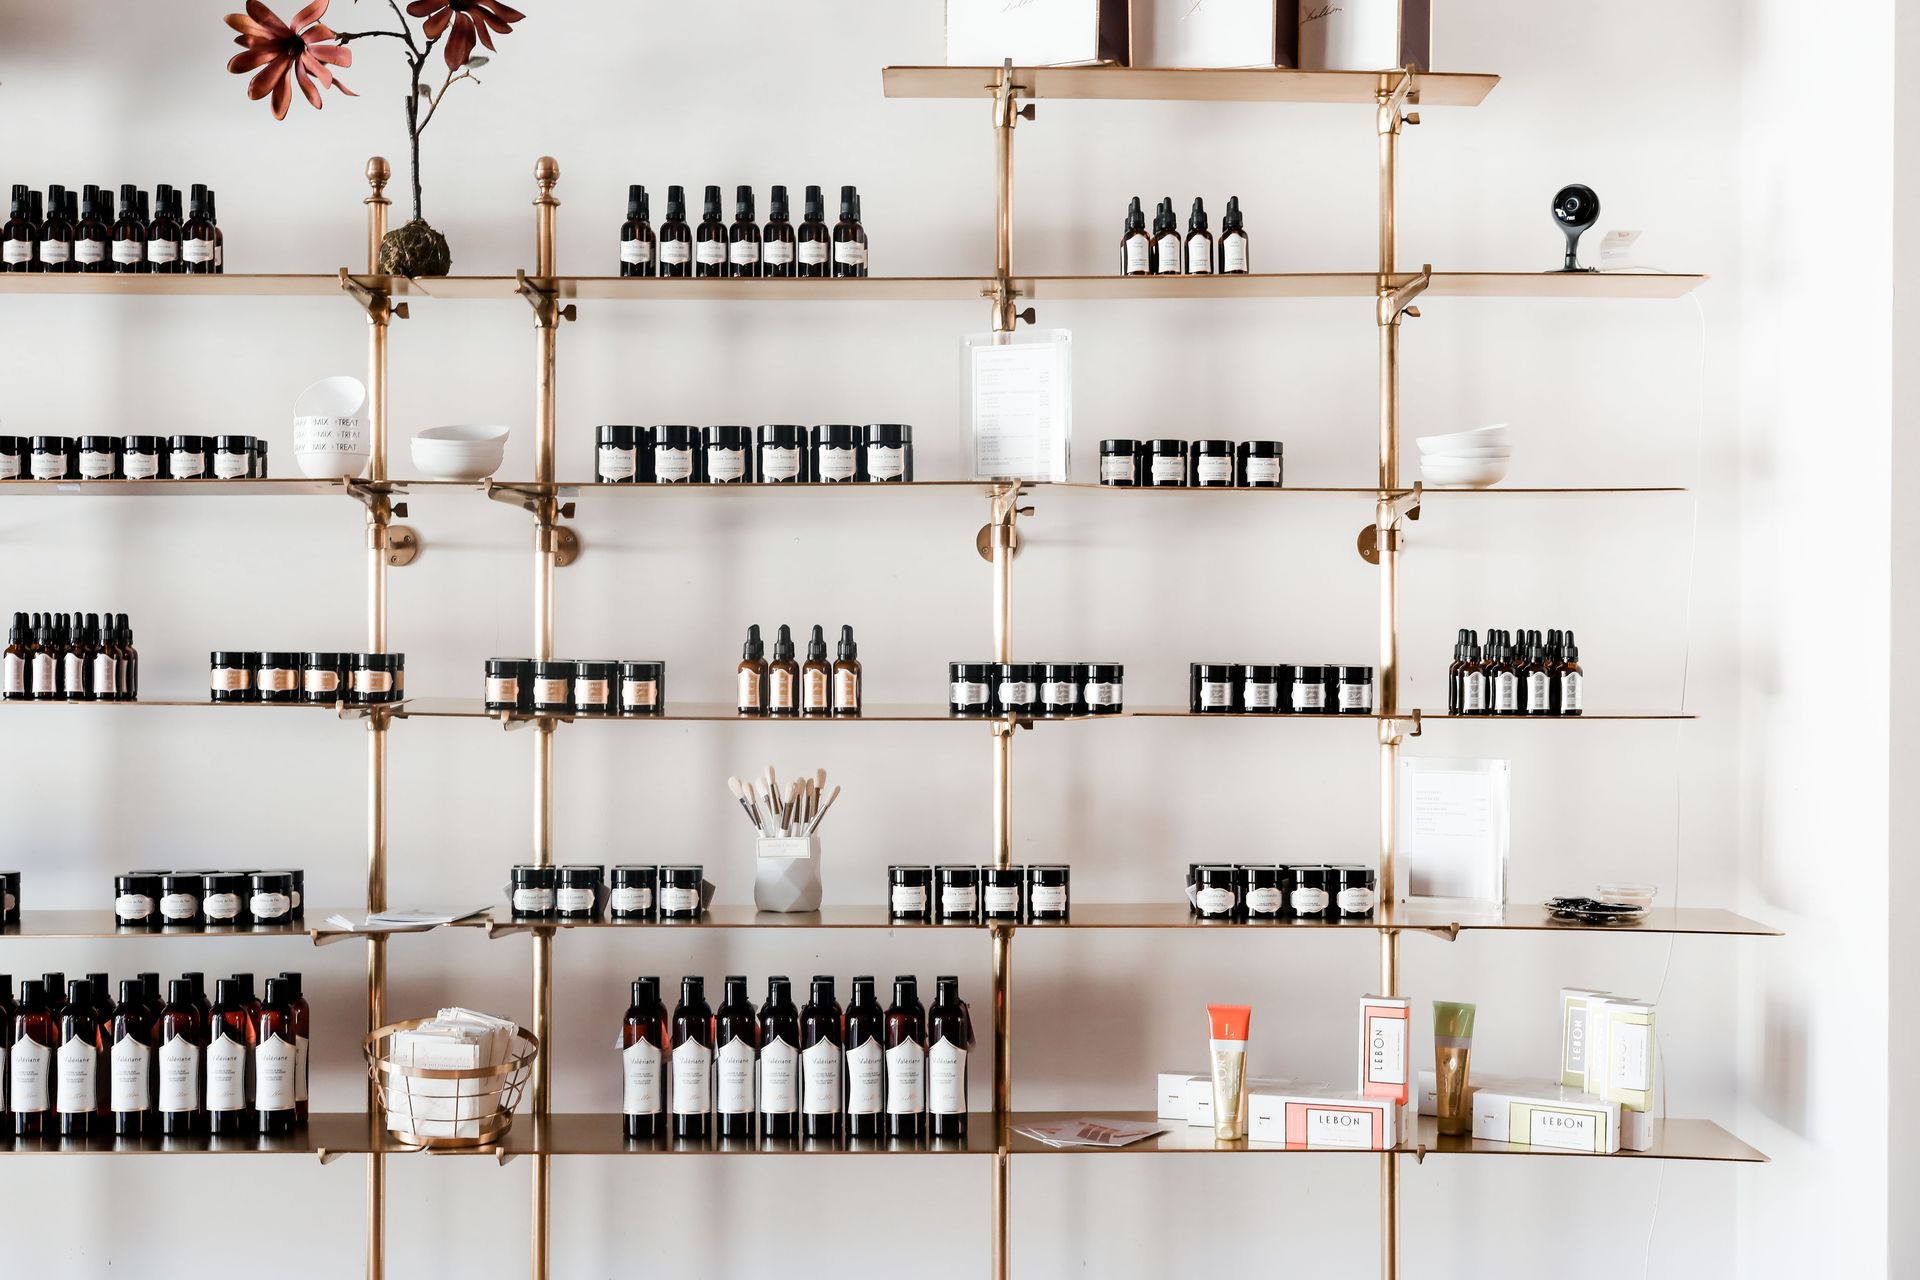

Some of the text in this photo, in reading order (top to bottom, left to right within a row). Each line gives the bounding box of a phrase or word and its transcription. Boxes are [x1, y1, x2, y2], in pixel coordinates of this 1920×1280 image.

[338, 418, 359, 427] TREAT
[341, 430, 361, 439] TREAT
[336, 443, 357, 451] TREAT
[1572, 1020, 1583, 1061] LEBON
[1373, 1029, 1384, 1070] LEBON
[1319, 1115, 1360, 1126] LEBON
[1543, 1116, 1583, 1128] LEBON
